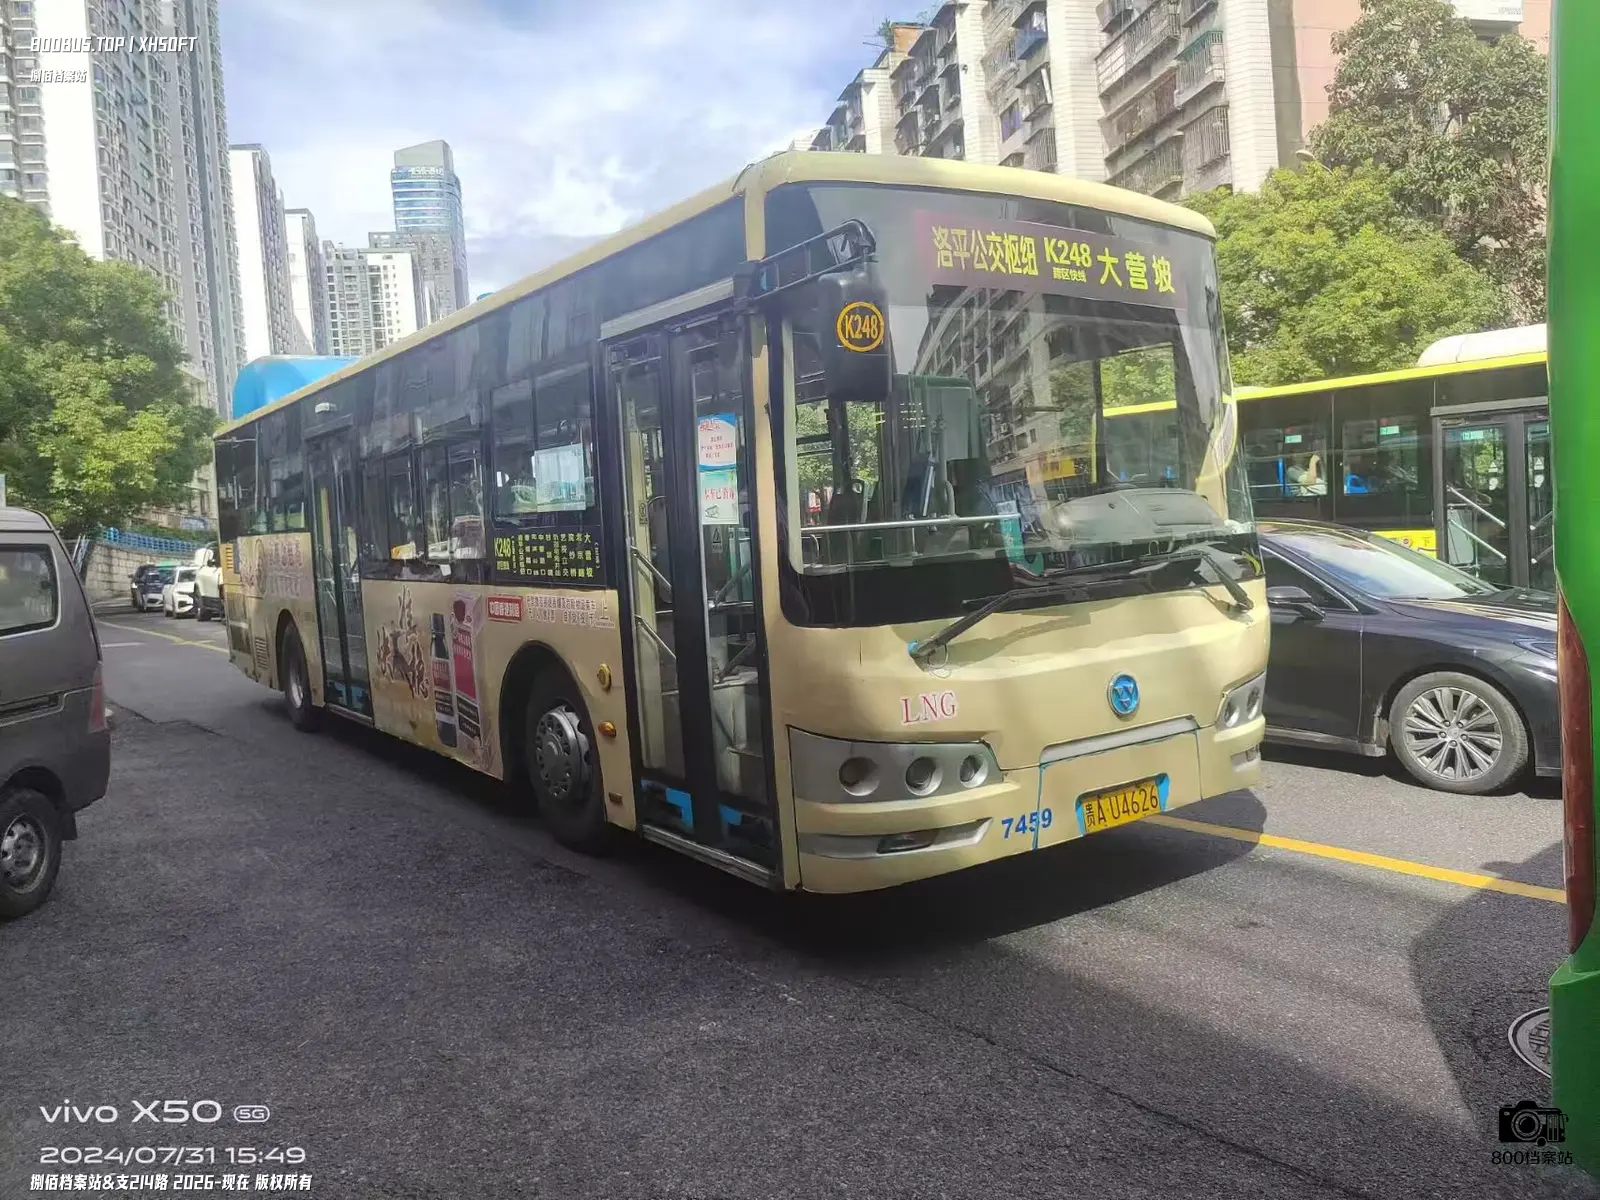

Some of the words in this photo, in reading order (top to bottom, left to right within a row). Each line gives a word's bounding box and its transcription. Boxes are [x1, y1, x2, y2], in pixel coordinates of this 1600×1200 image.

[932, 227, 1039, 276] 洛平公交枢纽
[1043, 237, 1093, 268] K248
[1096, 247, 1175, 294] 大营坡
[845, 314, 879, 340] K248
[494, 537, 511, 557] K248
[902, 691, 956, 723] LNG
[1001, 809, 1052, 839] 7459
